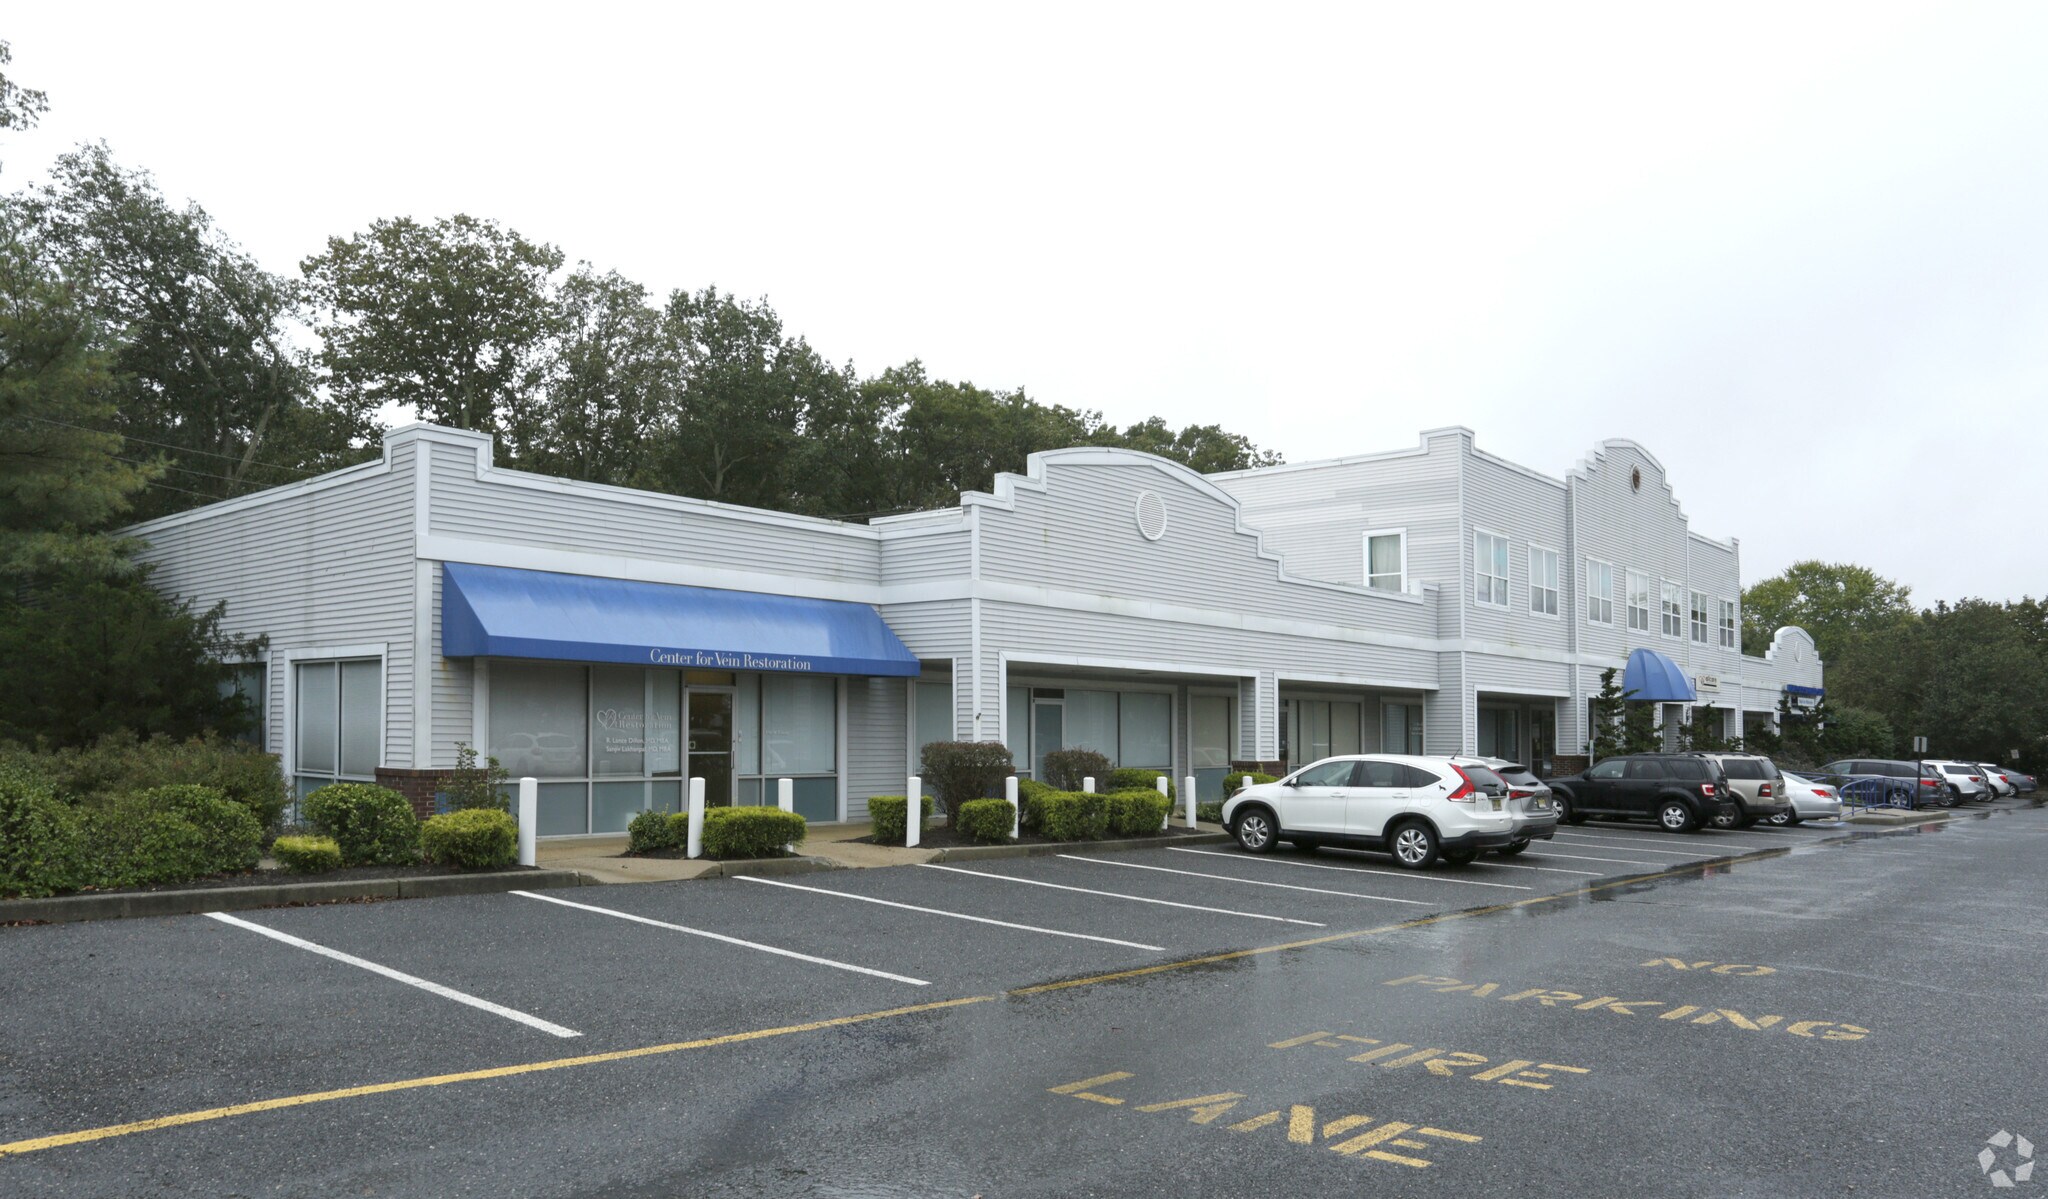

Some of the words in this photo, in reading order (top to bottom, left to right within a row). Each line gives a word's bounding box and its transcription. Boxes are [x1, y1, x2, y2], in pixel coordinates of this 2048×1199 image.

[650, 648, 693, 665] Center
[696, 651, 714, 666] for
[714, 652, 740, 667] Vein
[743, 654, 811, 671] Restoration
[618, 711, 643, 720] Center
[656, 711, 672, 720] Vein
[619, 720, 672, 729] Restoration
[1639, 957, 1777, 977] NO
[1382, 974, 1872, 1042] PARKING
[1266, 1031, 1592, 1091] FIRE
[1045, 1071, 1484, 1169] LANE
